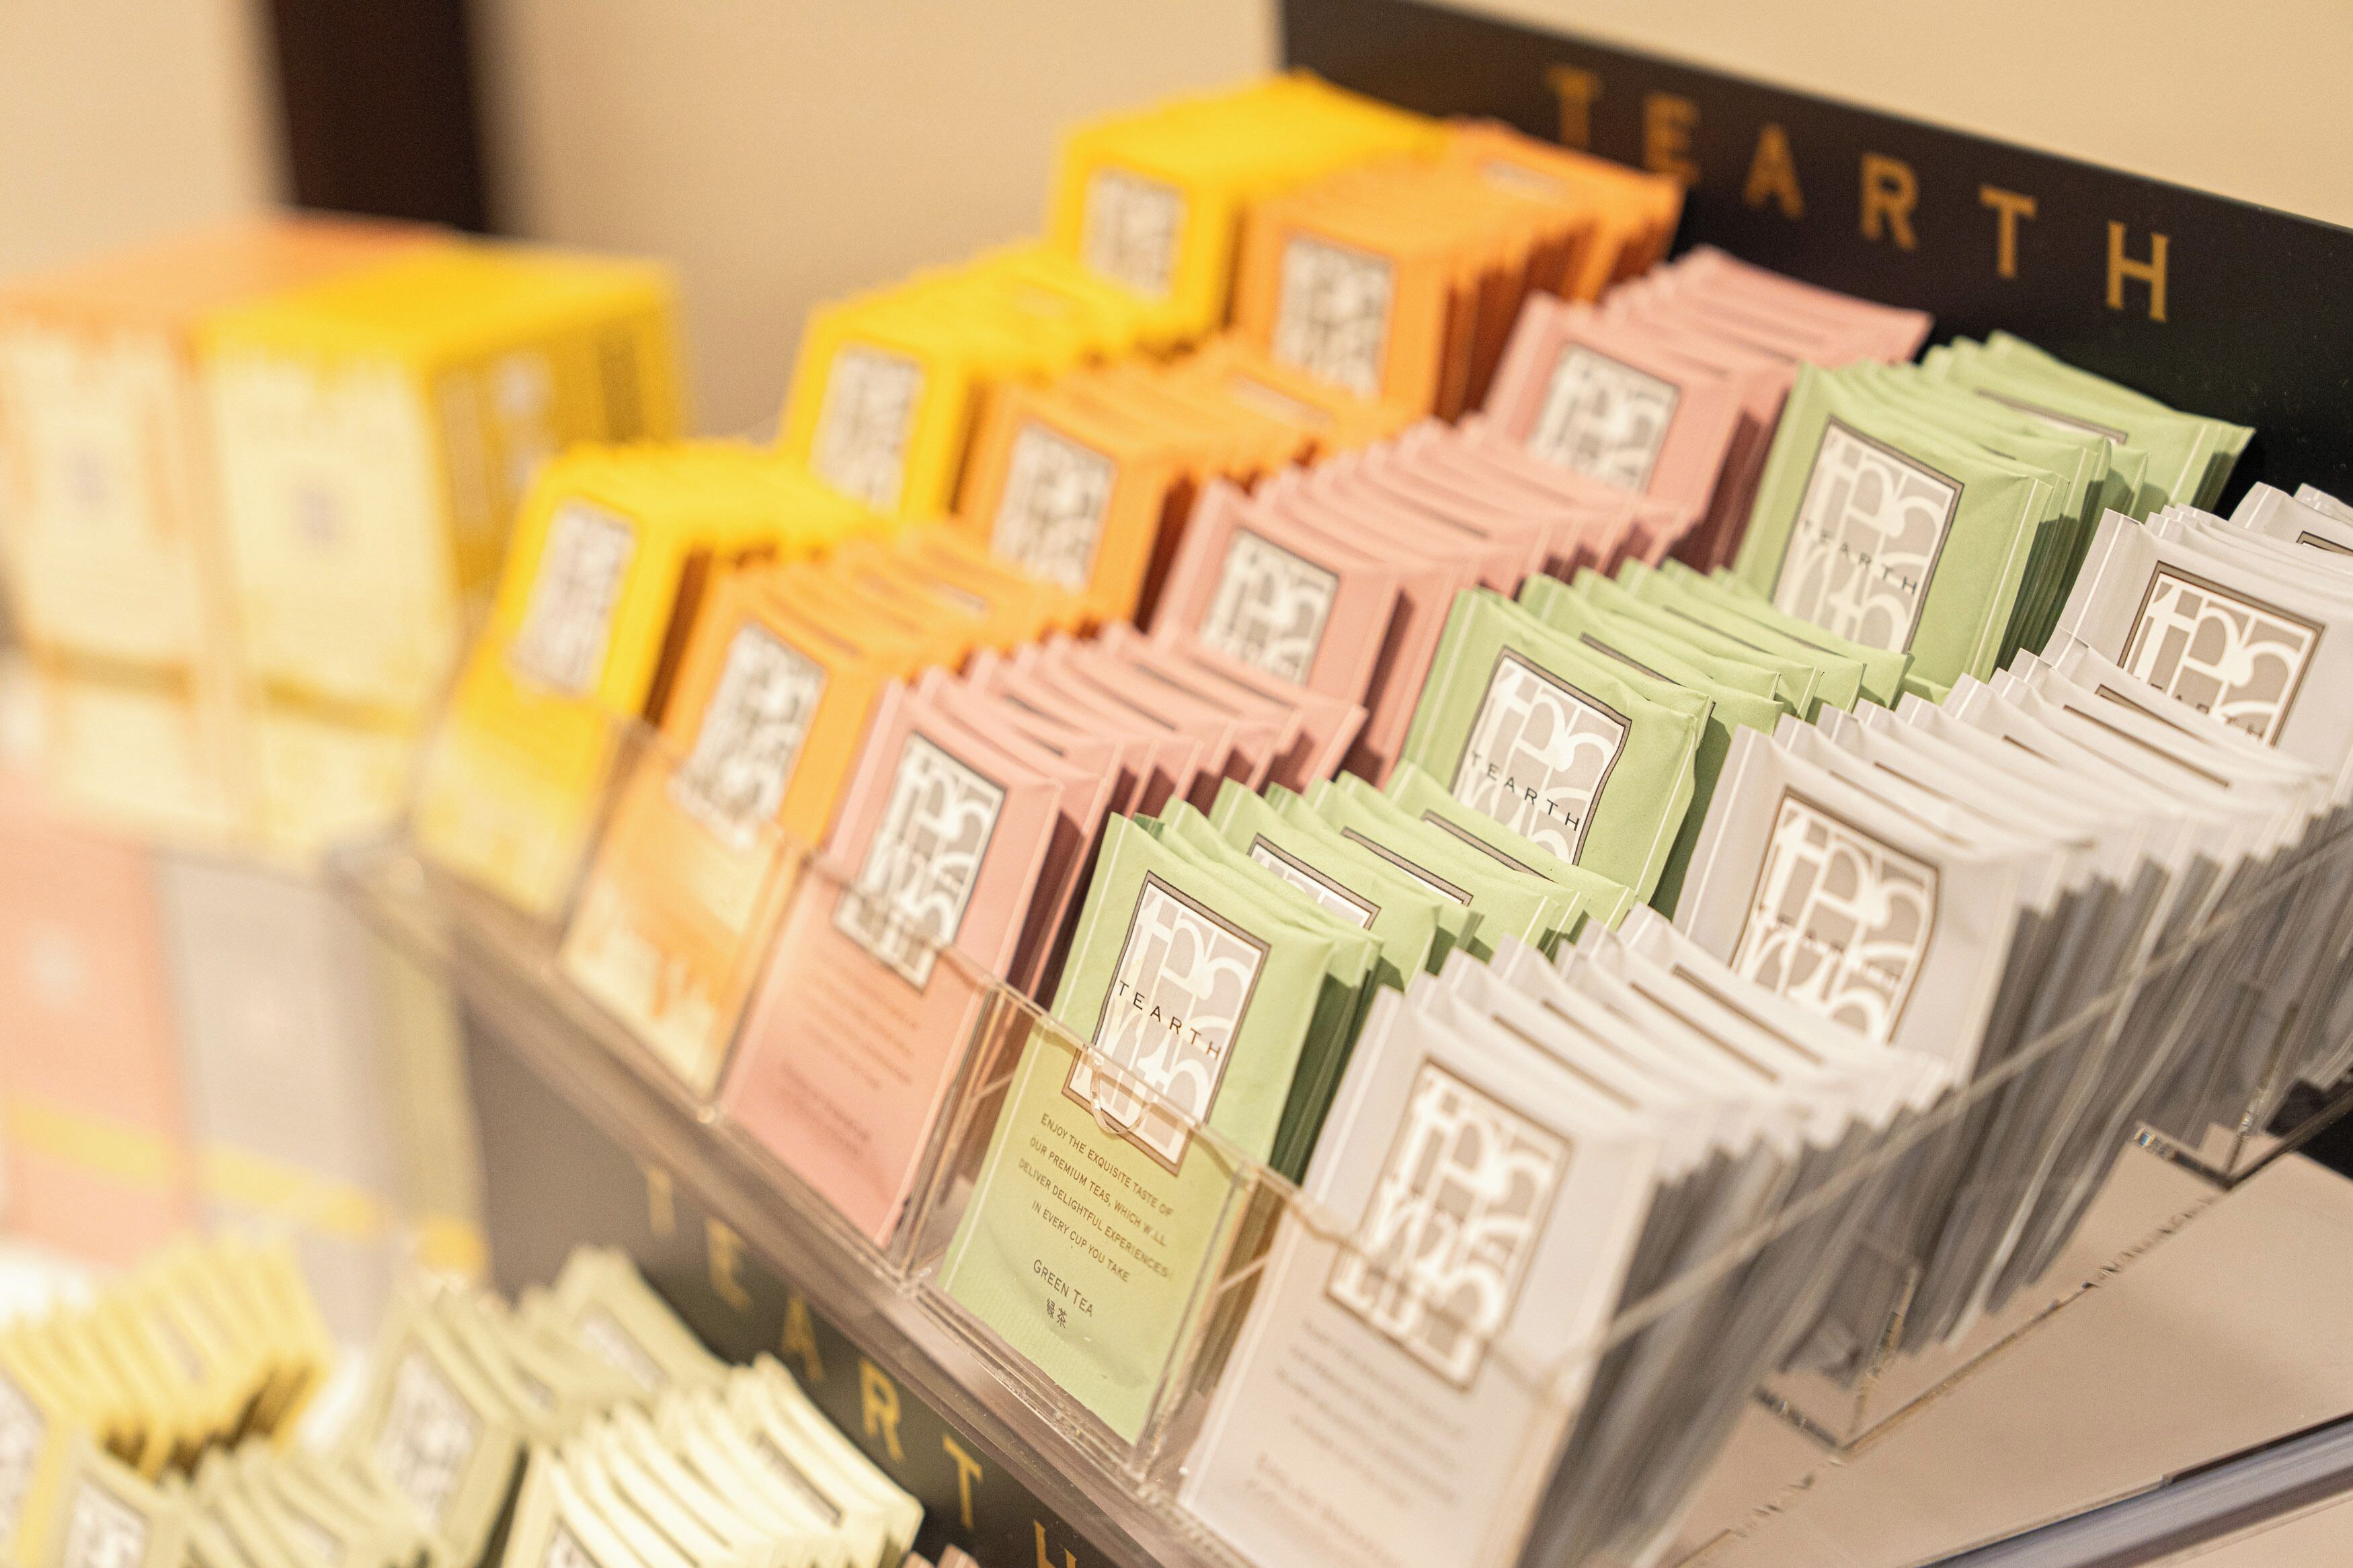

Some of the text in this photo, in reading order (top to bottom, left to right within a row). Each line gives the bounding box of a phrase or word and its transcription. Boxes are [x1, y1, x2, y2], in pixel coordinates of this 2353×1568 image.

[1542, 63, 2169, 323] TEARTH
[1804, 518, 1917, 596] TEARTH
[1471, 751, 1580, 831] TEARTH
[1119, 980, 1222, 1060] TEARTH
[1019, 1158, 1051, 1190] DELIVER
[1051, 1184, 1103, 1231] DELIGHTFUL
[1029, 1137, 1047, 1157] OUR
[1048, 1152, 1087, 1187] PREMIUM
[1089, 1182, 1111, 1207] TEAS,
[1113, 1199, 1147, 1228] WHICH
[1041, 1113, 1174, 1218] ENJOY THE EXQUISITE TASTE OF
[1031, 1199, 1131, 1283] IN EVERY CUP YOU TAKE
